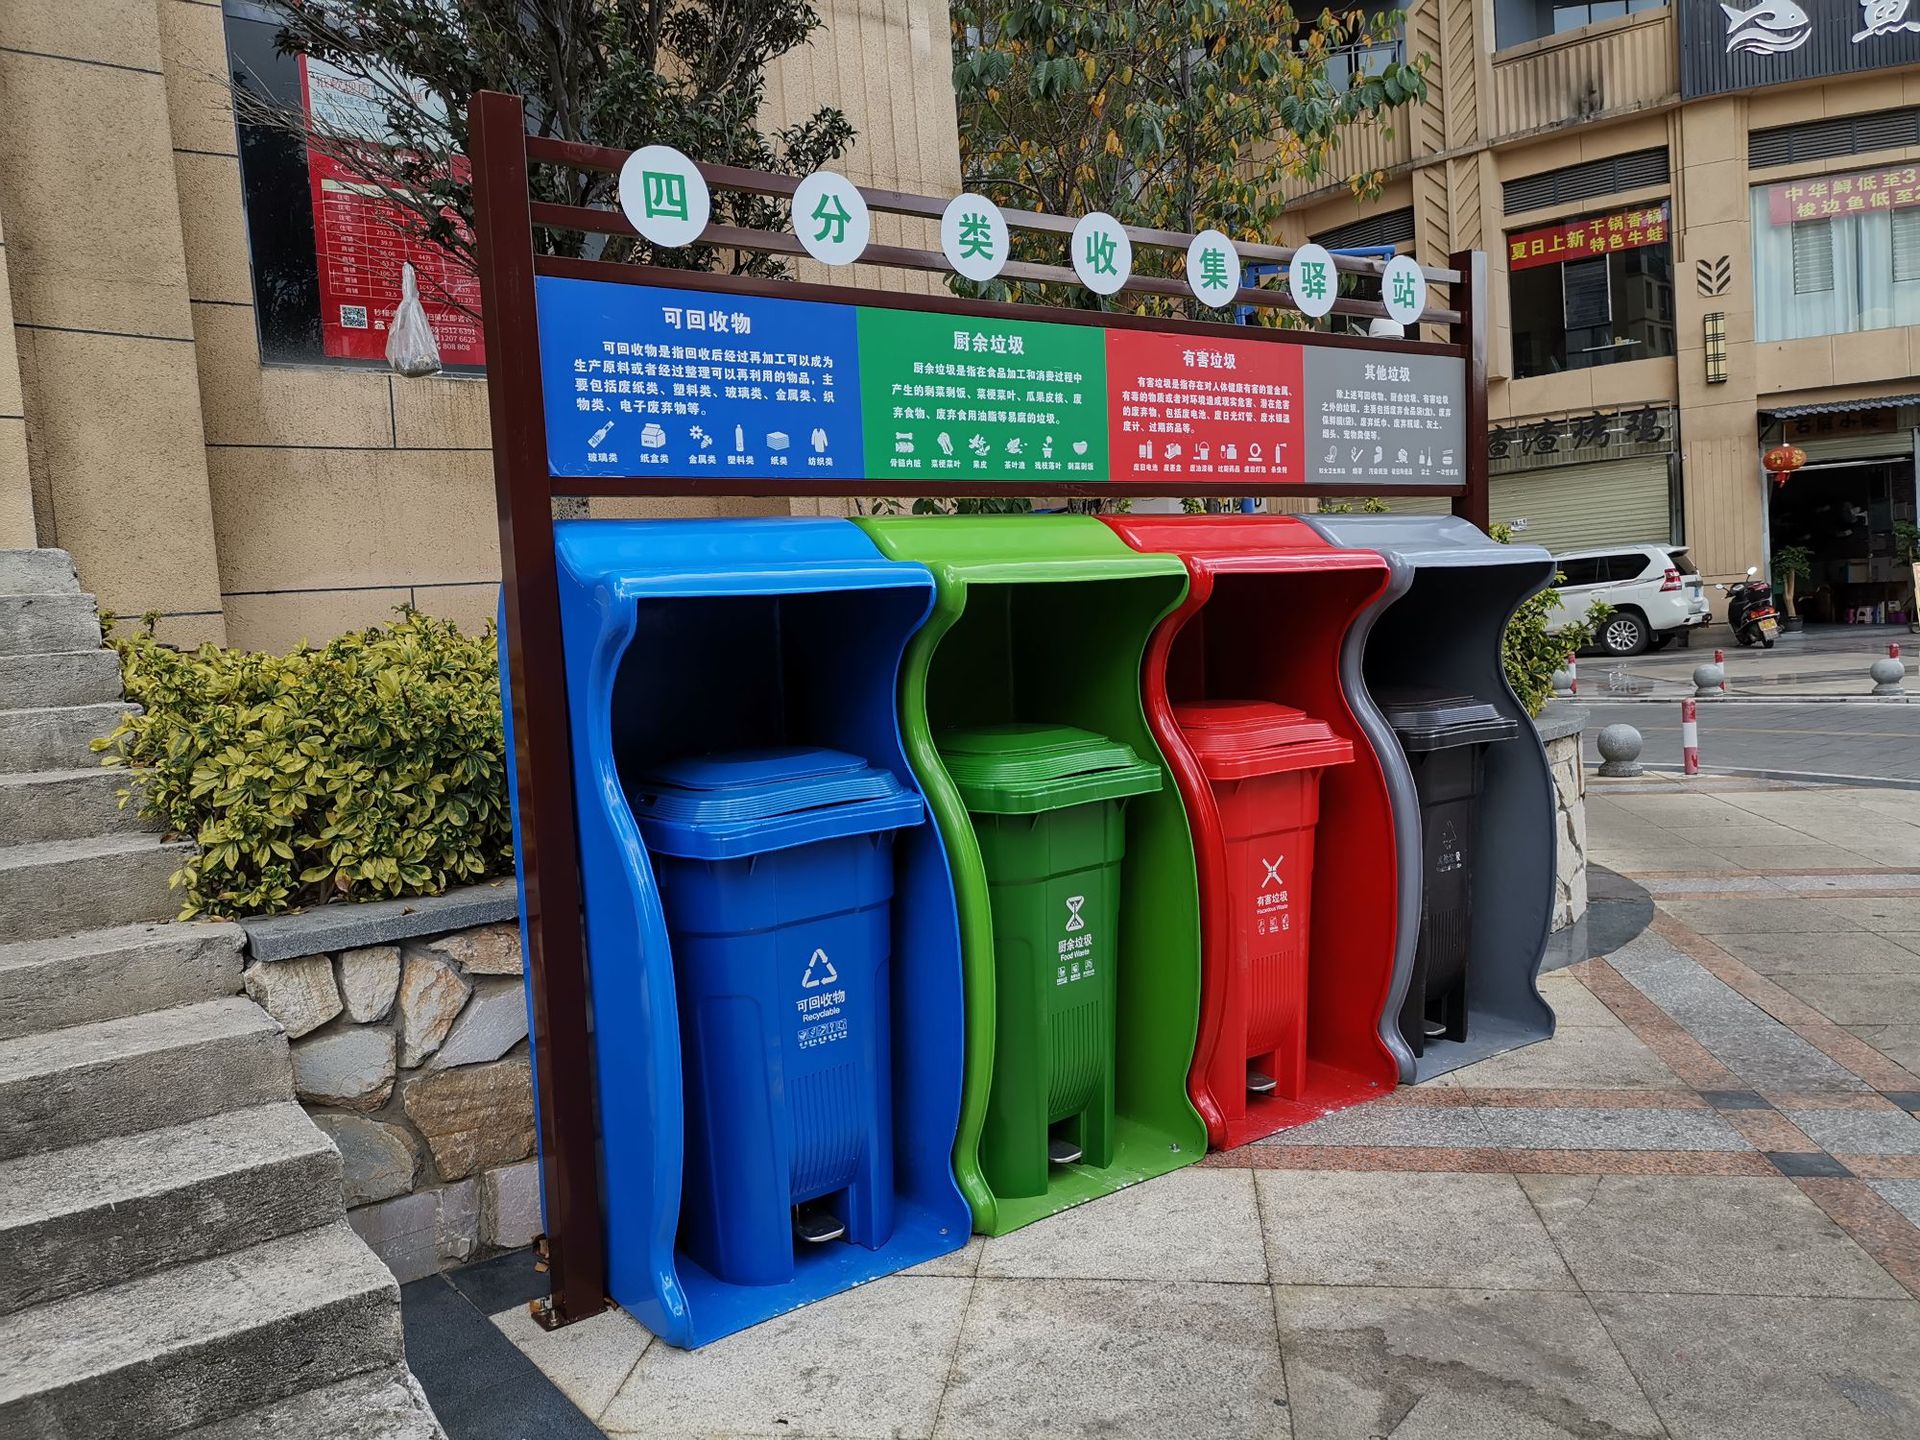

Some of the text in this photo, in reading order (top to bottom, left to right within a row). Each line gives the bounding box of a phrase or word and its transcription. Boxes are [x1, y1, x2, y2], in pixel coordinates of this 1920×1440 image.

[642, 171, 1416, 309] 四 分 类 收 集 驿 站
[1511, 229, 1585, 261] 夏日上新
[1590, 227, 1663, 253] 特色牛蛙
[662, 306, 751, 335] 可回收物
[954, 331, 1025, 355] 厨余垃圾
[602, 341, 833, 369] 可回收物是指回收后经过再加工可以成为
[1182, 349, 1237, 370] 有害垃圾
[573, 359, 834, 386] 生产原料或者经过整理可以再利用的物品，主
[913, 361, 1083, 384] 厨余垃圾是指在食品加工和消费过程中
[1364, 363, 1410, 383] 其他垃圾
[574, 377, 835, 403] 要包括废纸类、塑料类、玻璃类、金属类、织
[891, 383, 1083, 405] 产生的剩菜剩饭、菜梗菜叶、瓜果皮核、废
[576, 397, 707, 417] 物类、电子废弃物等。
[587, 452, 618, 464] 玻璃类
[640, 453, 669, 465] 纸盒类
[688, 454, 717, 466] 金属类
[727, 455, 755, 466] 塑料类
[770, 456, 788, 467] 纸类
[808, 456, 833, 467] 纺织类
[1058, 934, 1092, 953] 厨余垃圾
[796, 989, 846, 1013] 可回收物
[802, 1006, 841, 1022] Recyclable
